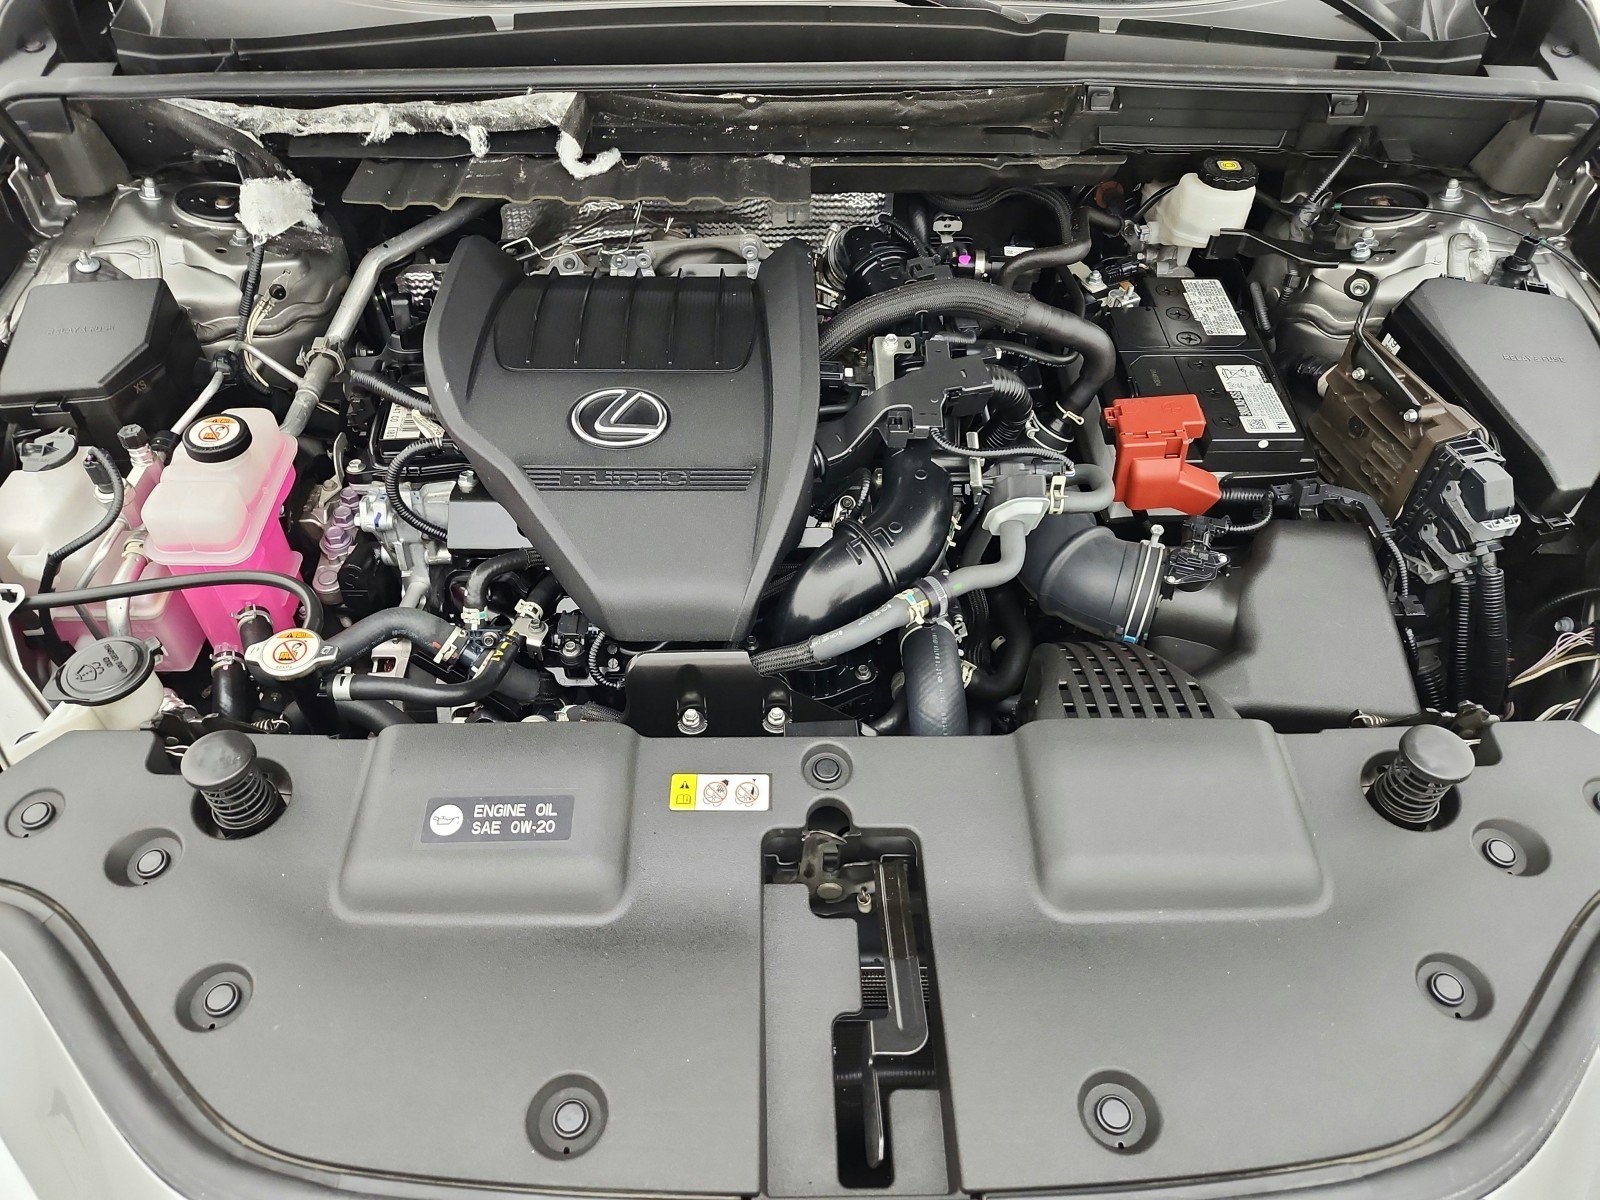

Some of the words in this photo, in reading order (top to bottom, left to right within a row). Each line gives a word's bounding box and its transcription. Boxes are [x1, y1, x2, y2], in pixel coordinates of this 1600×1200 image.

[563, 469, 688, 486] TURBO
[473, 803, 526, 818] ENGINE
[535, 803, 558, 817] OIL
[471, 821, 502, 835] SAE
[510, 820, 556, 834] 0W-20
